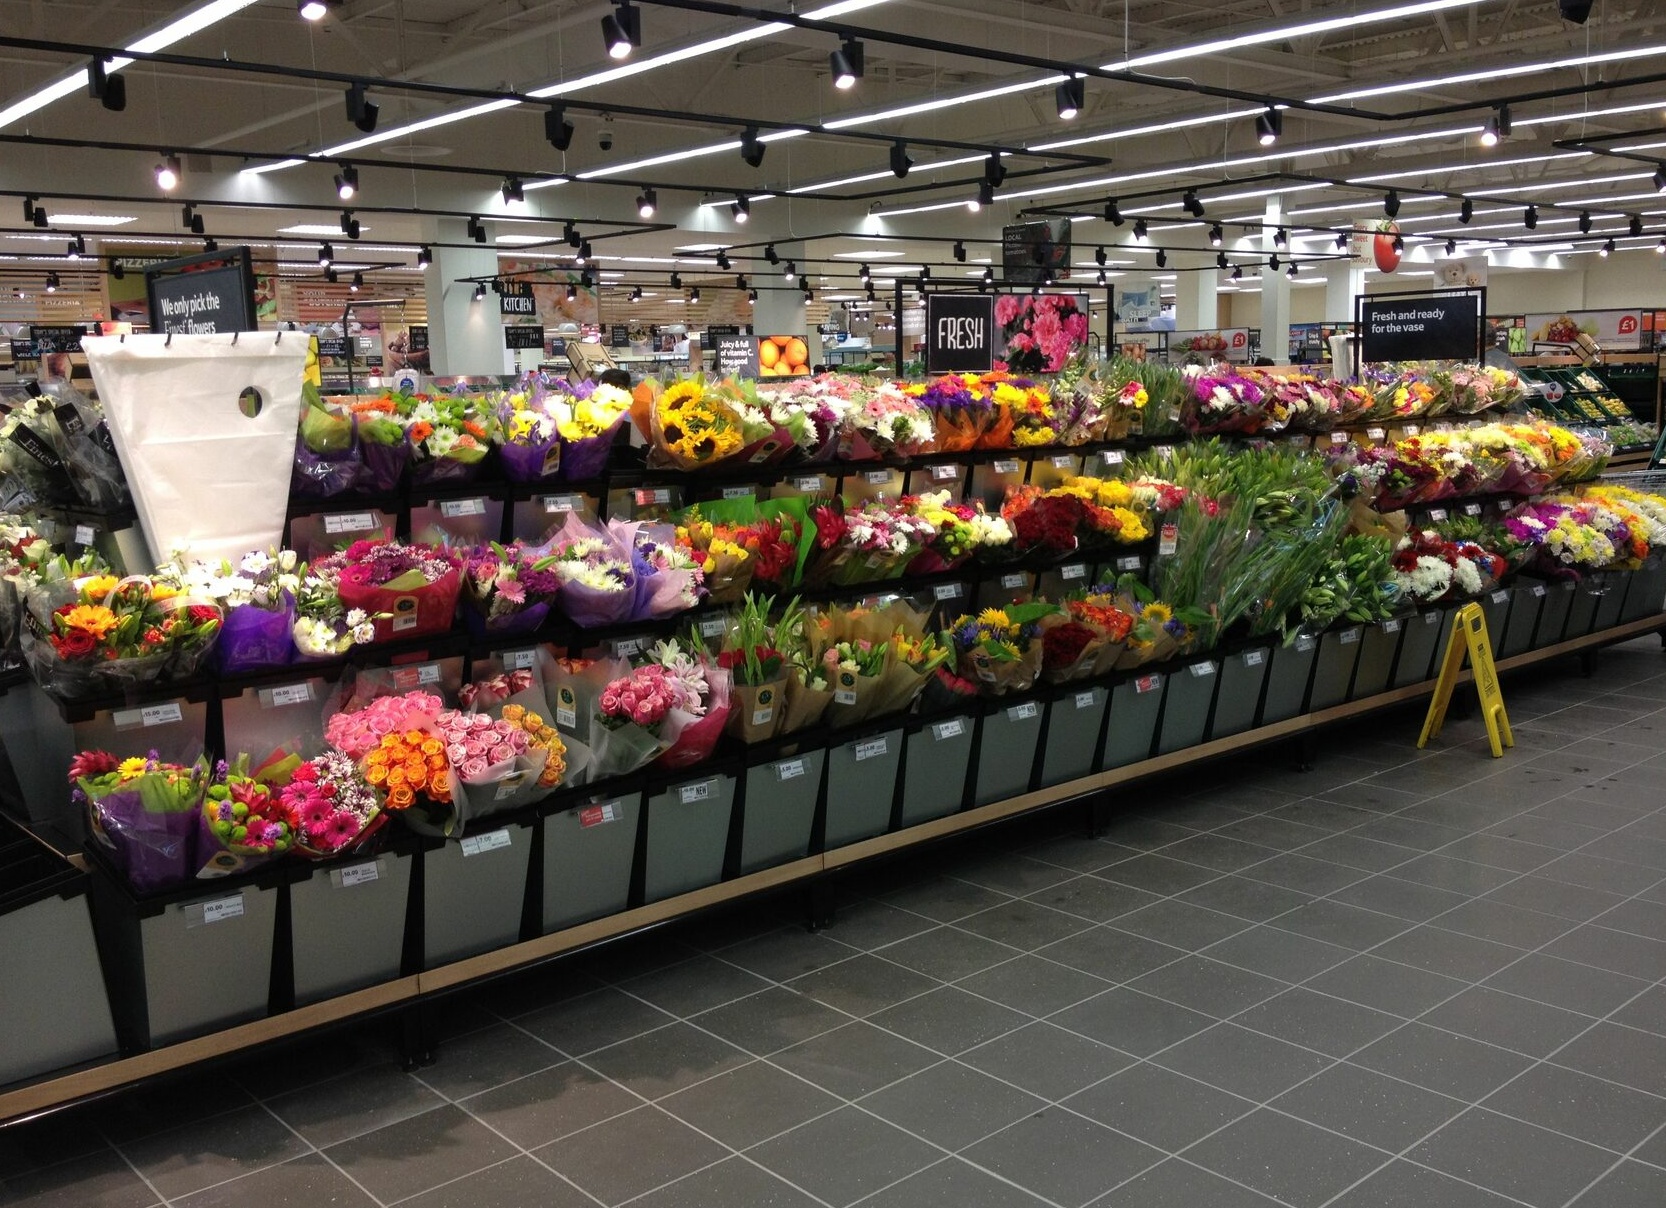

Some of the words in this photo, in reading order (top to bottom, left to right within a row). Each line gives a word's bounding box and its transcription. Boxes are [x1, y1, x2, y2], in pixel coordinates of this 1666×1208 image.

[161, 298, 173, 316] We
[173, 295, 189, 317] only
[190, 292, 207, 317] pick
[207, 291, 220, 310] the
[503, 297, 532, 313] KITCHEN
[1371, 311, 1396, 321] Fresh
[1398, 309, 1416, 320] and
[1417, 308, 1445, 320] ready
[187, 318, 216, 335] flowers
[1371, 323, 1386, 334] for
[1386, 322, 1402, 333] the
[1403, 323, 1425, 332] vase
[1621, 319, 1635, 331] £1
[938, 317, 984, 350] FRESH
[720, 340, 735, 349] Juicy
[735, 340, 740, 348] &
[740, 340, 749, 348] full
[720, 349, 727, 357] of
[726, 348, 747, 357] vitamin
[747, 348, 754, 357] C.
[720, 357, 732, 366] How
[734, 357, 748, 366] good
[696, 785, 707, 796] NEW
